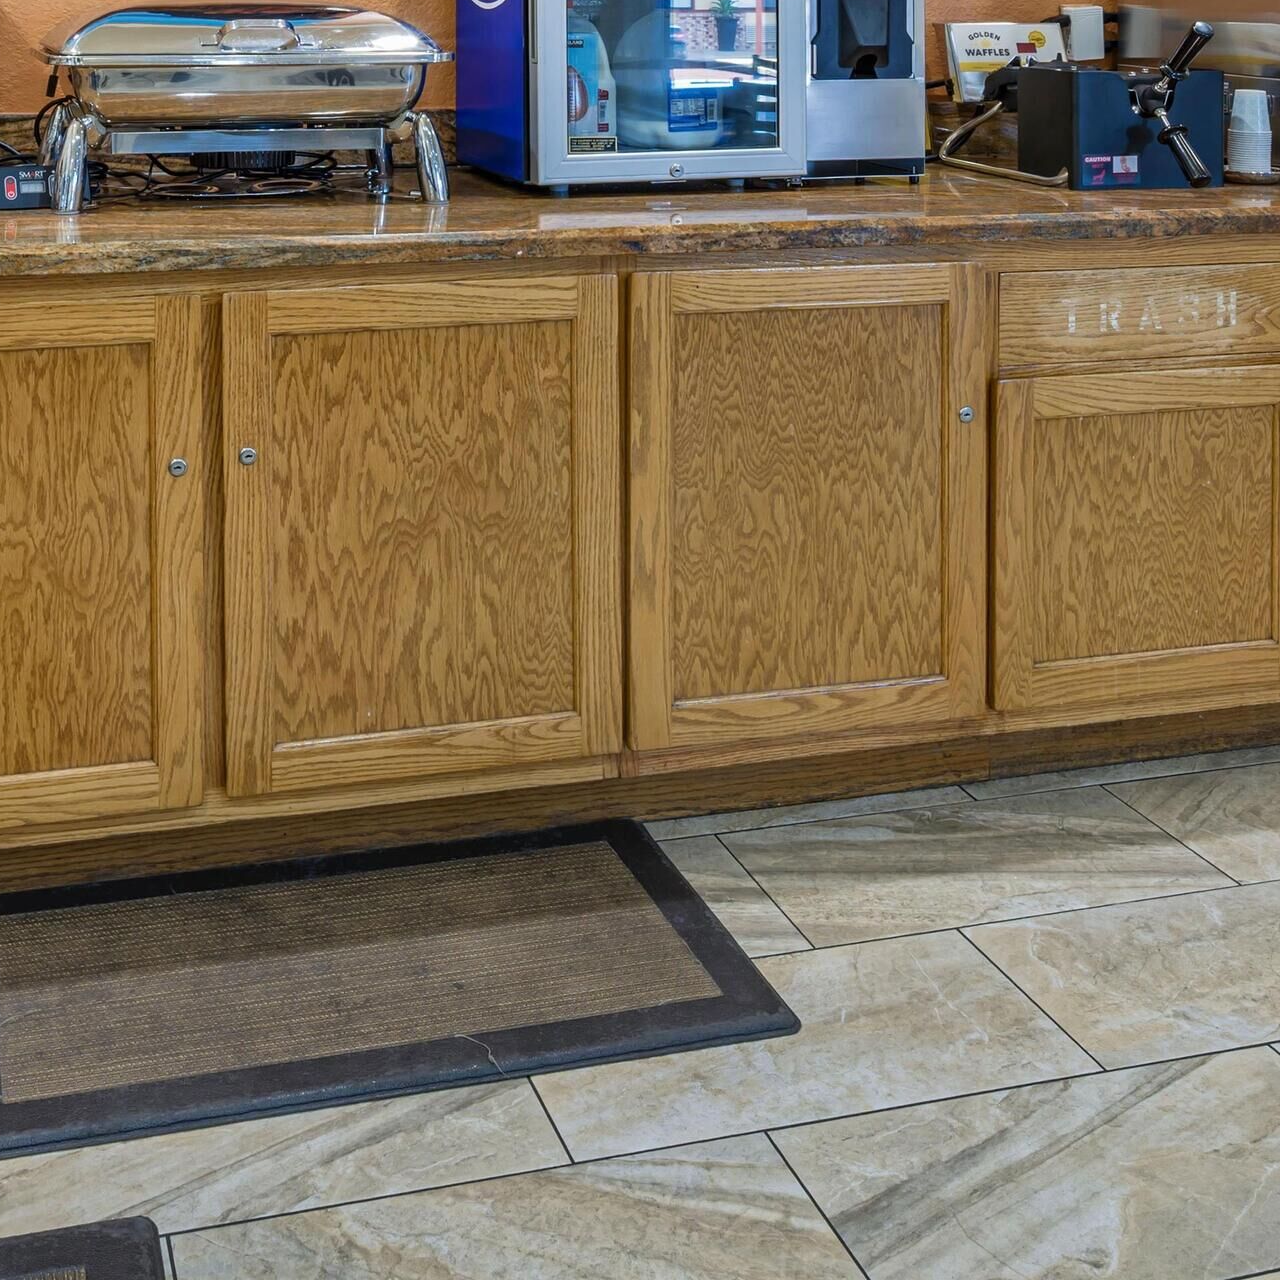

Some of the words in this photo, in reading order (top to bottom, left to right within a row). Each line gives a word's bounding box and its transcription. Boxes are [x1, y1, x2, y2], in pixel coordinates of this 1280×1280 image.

[968, 31, 1001, 41] GOLDEN
[965, 48, 1010, 57] WAFFLES
[1061, 287, 1238, 334] TRASH
